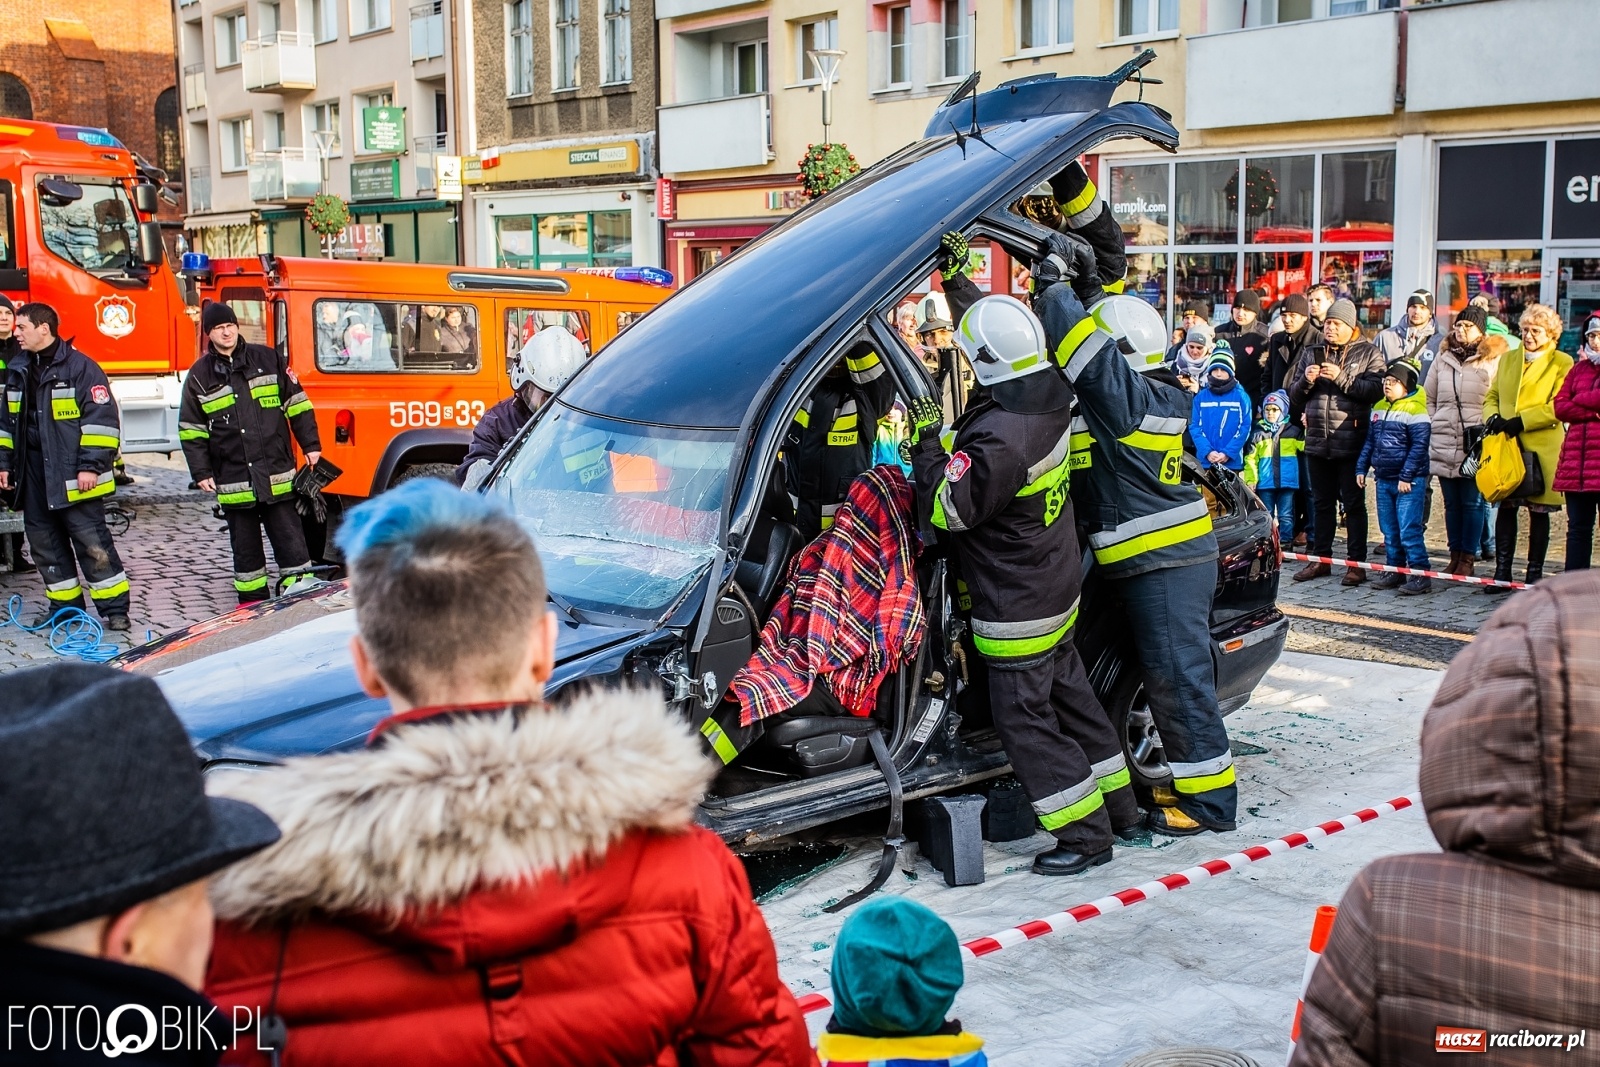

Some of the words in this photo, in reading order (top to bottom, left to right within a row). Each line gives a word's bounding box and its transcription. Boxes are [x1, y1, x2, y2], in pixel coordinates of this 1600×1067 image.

[571, 151, 598, 163] STEFCZYK
[600, 148, 626, 160] FINANSE
[662, 181, 671, 215] ŻYWIEC
[1567, 175, 1600, 203] e
[1113, 197, 1166, 215] empik.com
[389, 400, 441, 427] 569
[456, 400, 486, 427] 33
